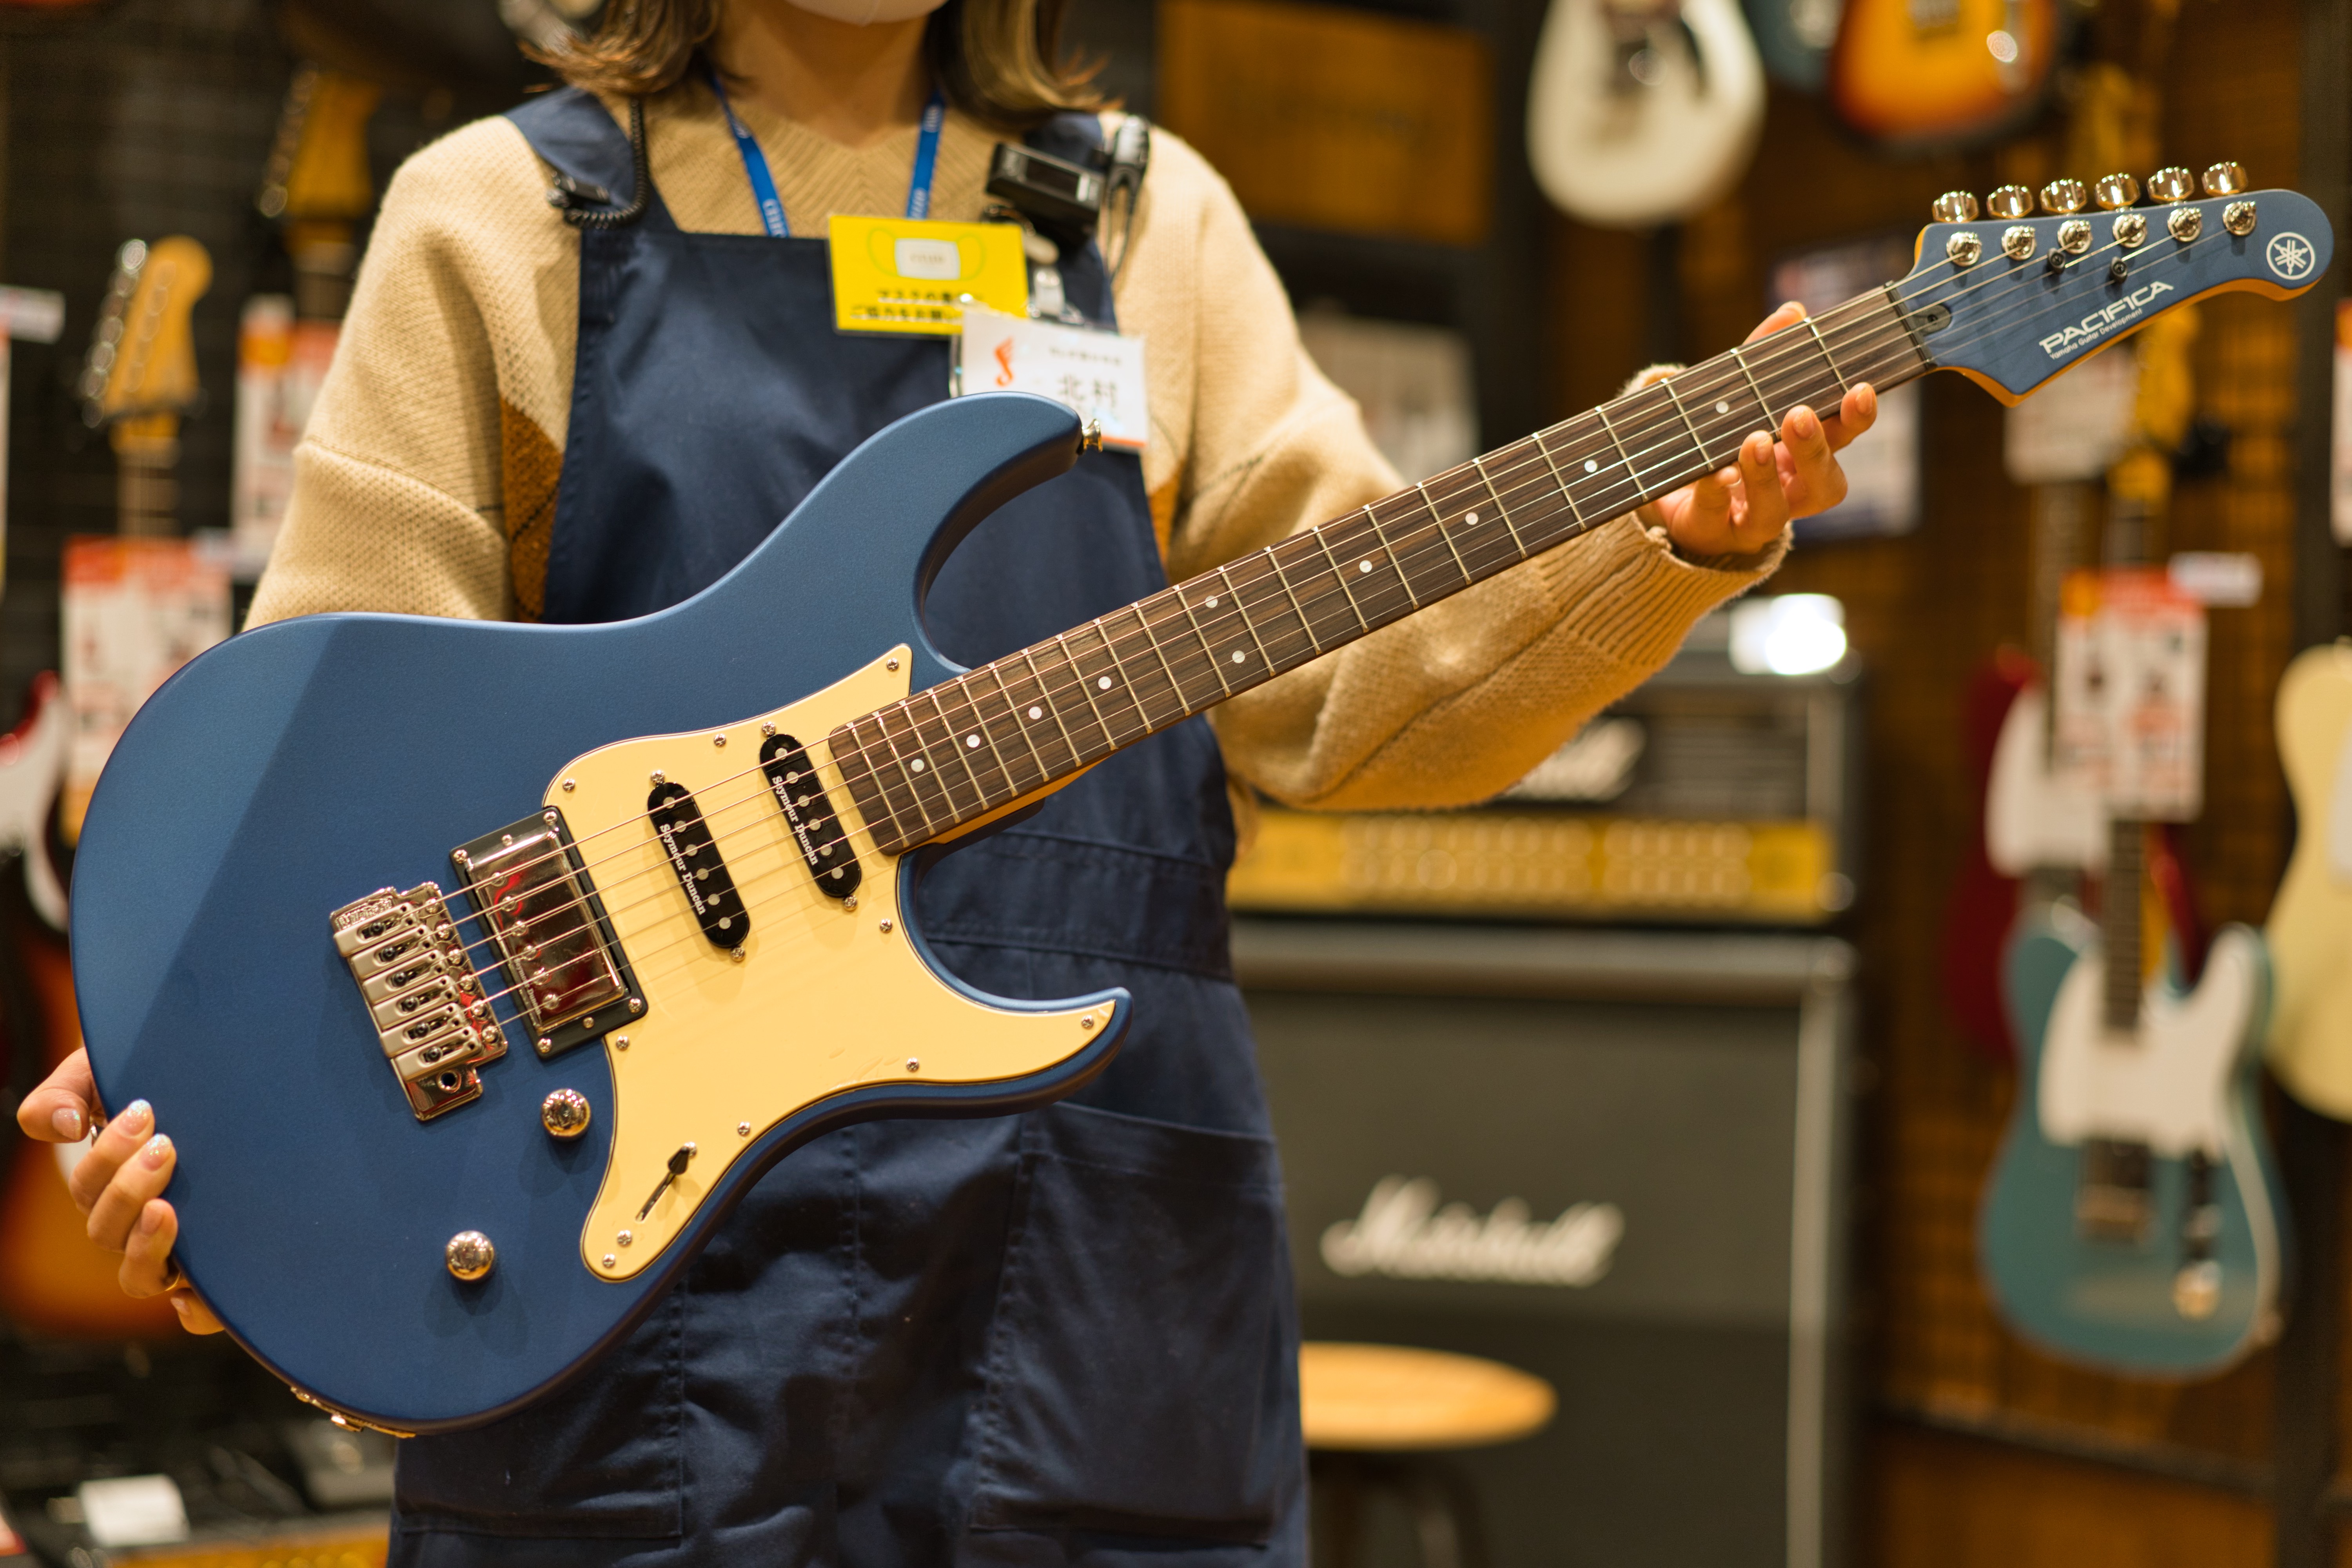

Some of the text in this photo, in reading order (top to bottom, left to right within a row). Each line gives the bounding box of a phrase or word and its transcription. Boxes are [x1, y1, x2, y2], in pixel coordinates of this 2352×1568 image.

[2039, 281, 2174, 354] PACIFICA
[2049, 308, 2143, 360] Yamaha Guitar Development
[772, 776, 818, 866] Seymour Duncan
[659, 824, 706, 915] Seymour Duncan
